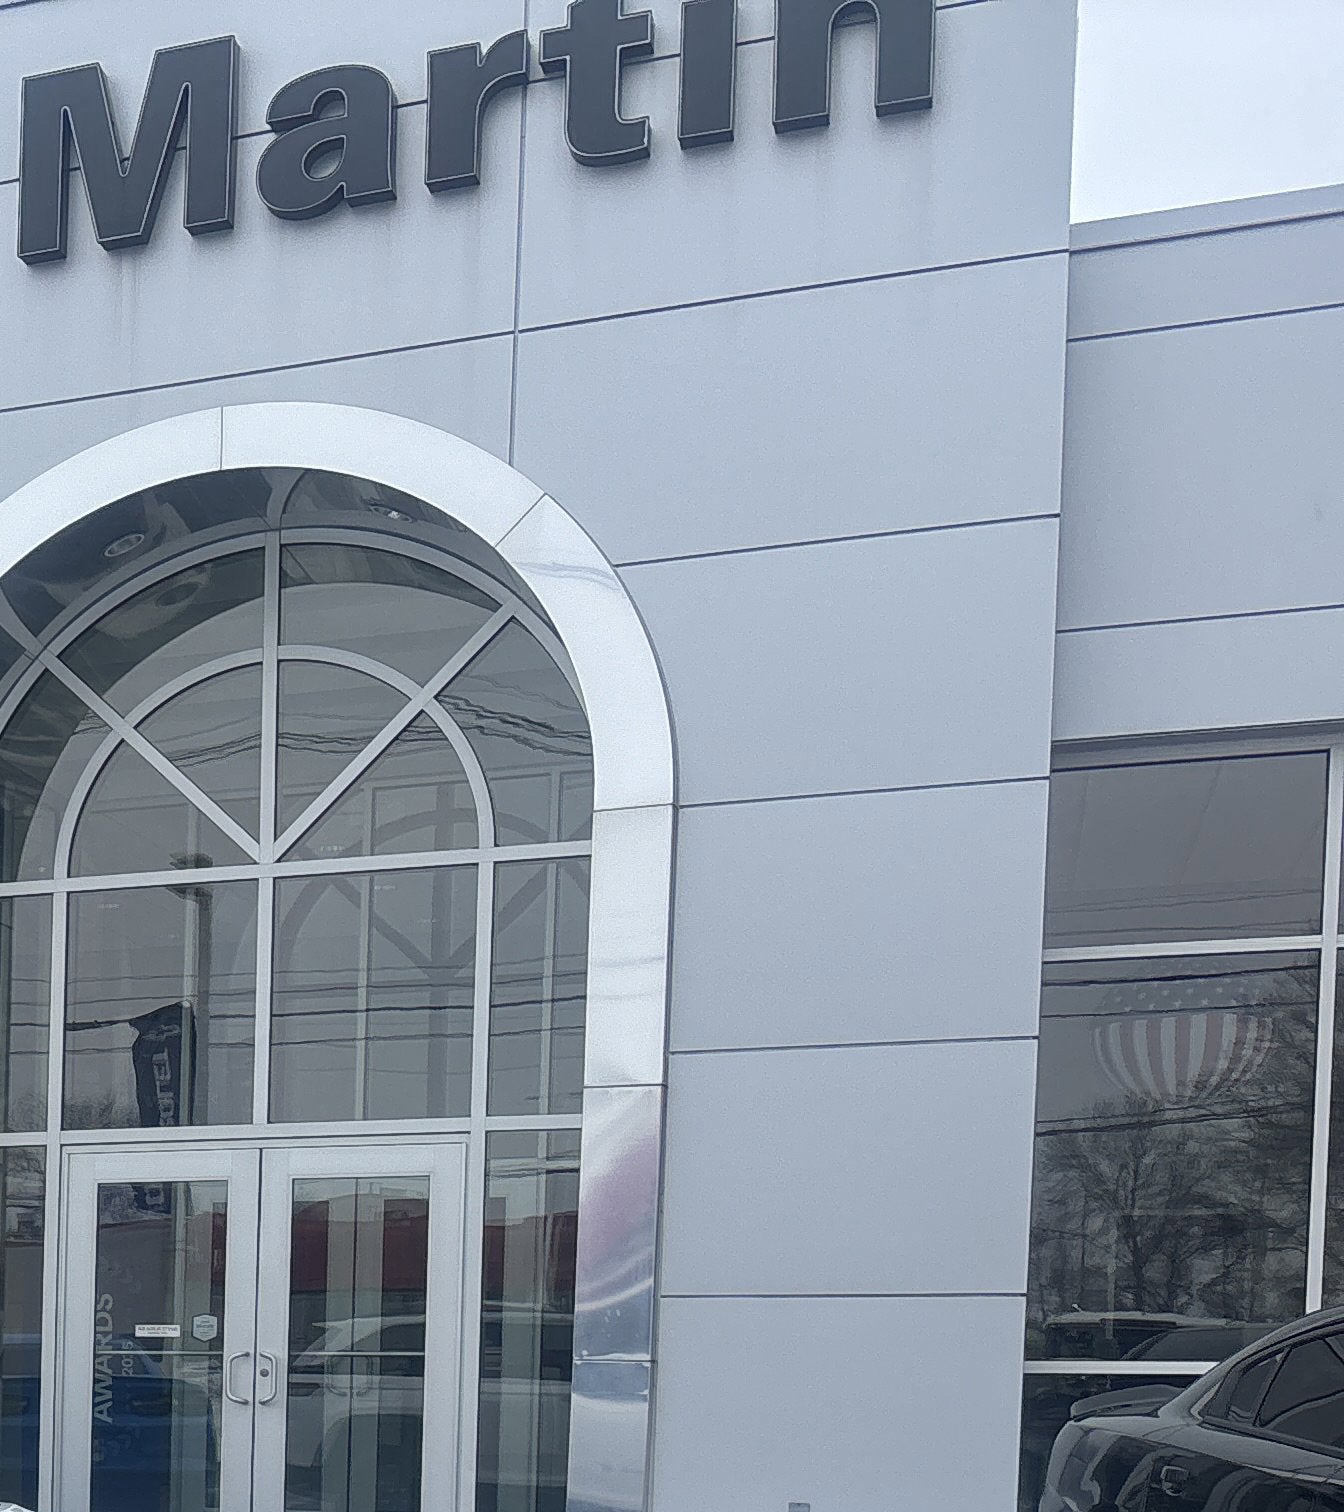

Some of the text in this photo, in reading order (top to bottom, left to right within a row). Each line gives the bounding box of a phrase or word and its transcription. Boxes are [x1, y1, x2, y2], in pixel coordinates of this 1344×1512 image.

[17, 0, 934, 266] Martin
[94, 1293, 113, 1423] AWARDS
[122, 1341, 134, 1376] 205
